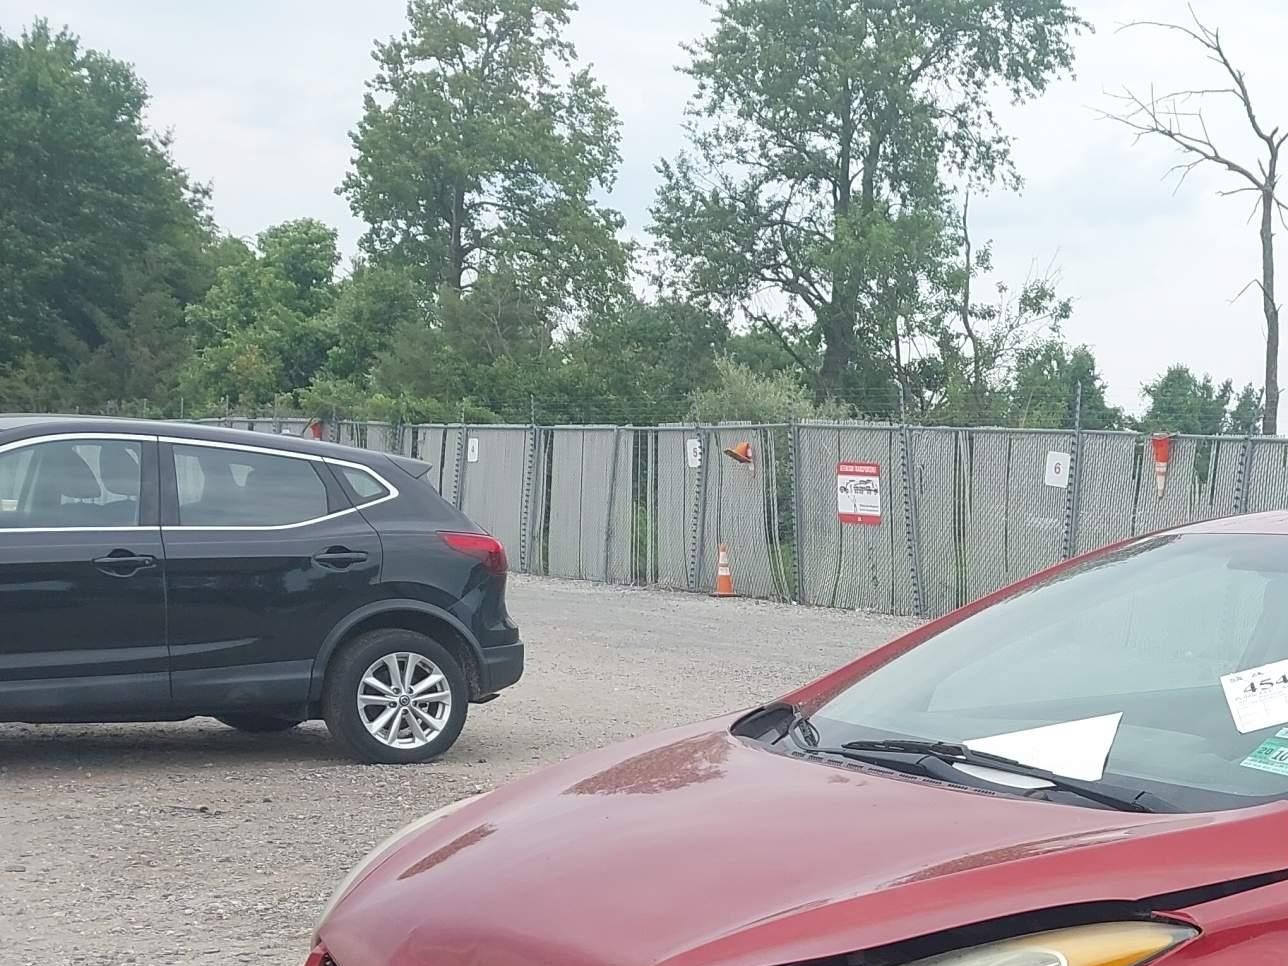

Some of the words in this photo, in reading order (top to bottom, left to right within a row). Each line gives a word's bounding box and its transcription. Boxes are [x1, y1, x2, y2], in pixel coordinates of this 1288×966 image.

[692, 447, 698, 458] 5
[1054, 462, 1061, 474] 6
[1257, 746, 1274, 755] 20
